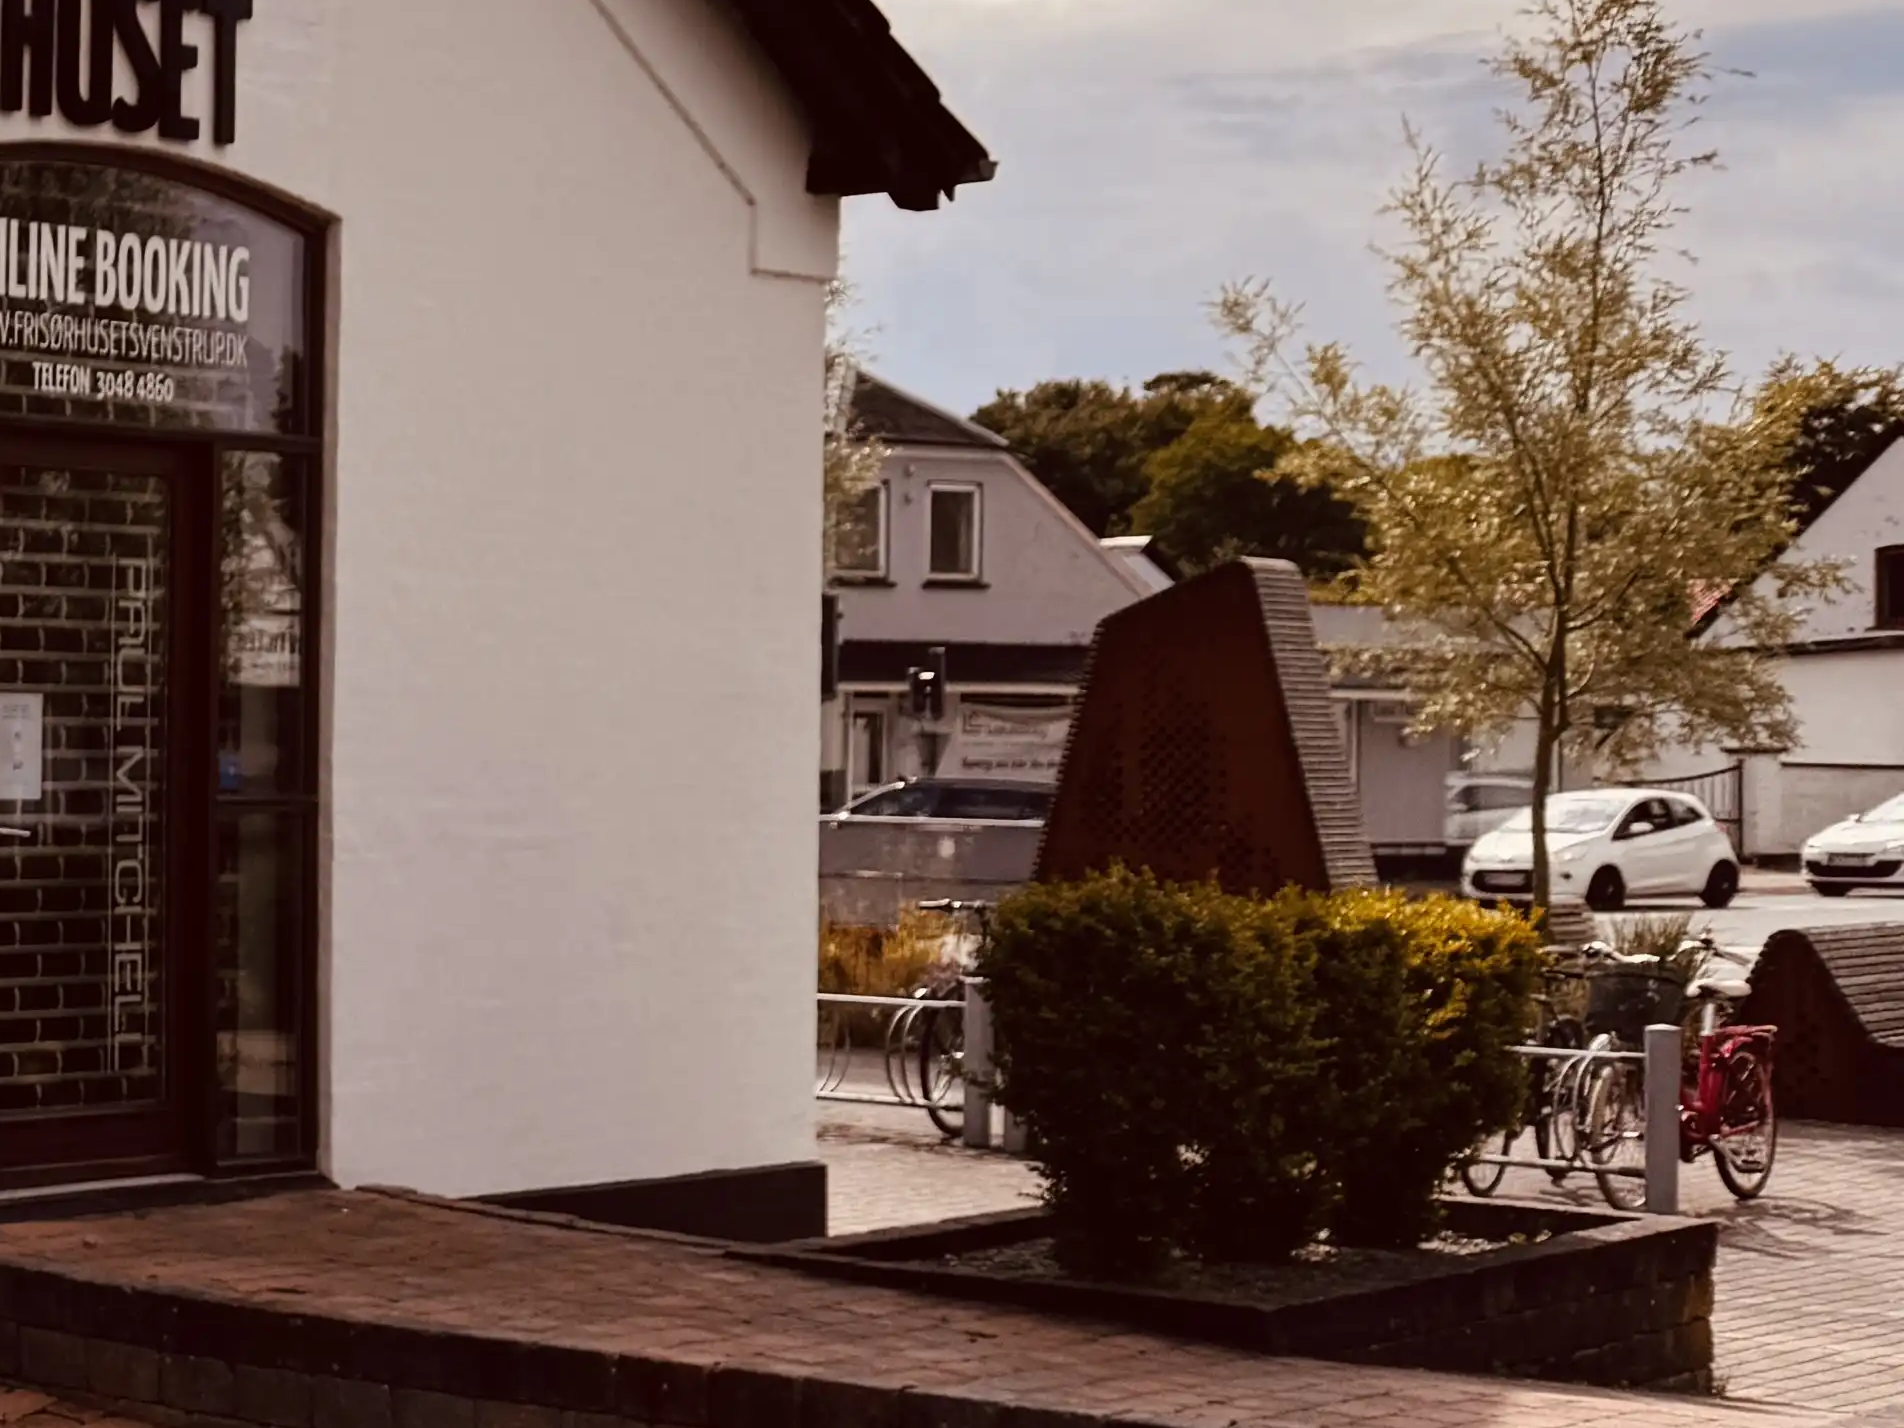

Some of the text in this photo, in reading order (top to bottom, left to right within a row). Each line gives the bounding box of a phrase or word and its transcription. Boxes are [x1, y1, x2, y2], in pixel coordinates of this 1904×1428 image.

[93, 229, 251, 322] BOOKING
[32, 361, 92, 395] TELEFON
[113, 557, 148, 1072] PAUL MITCHELL
